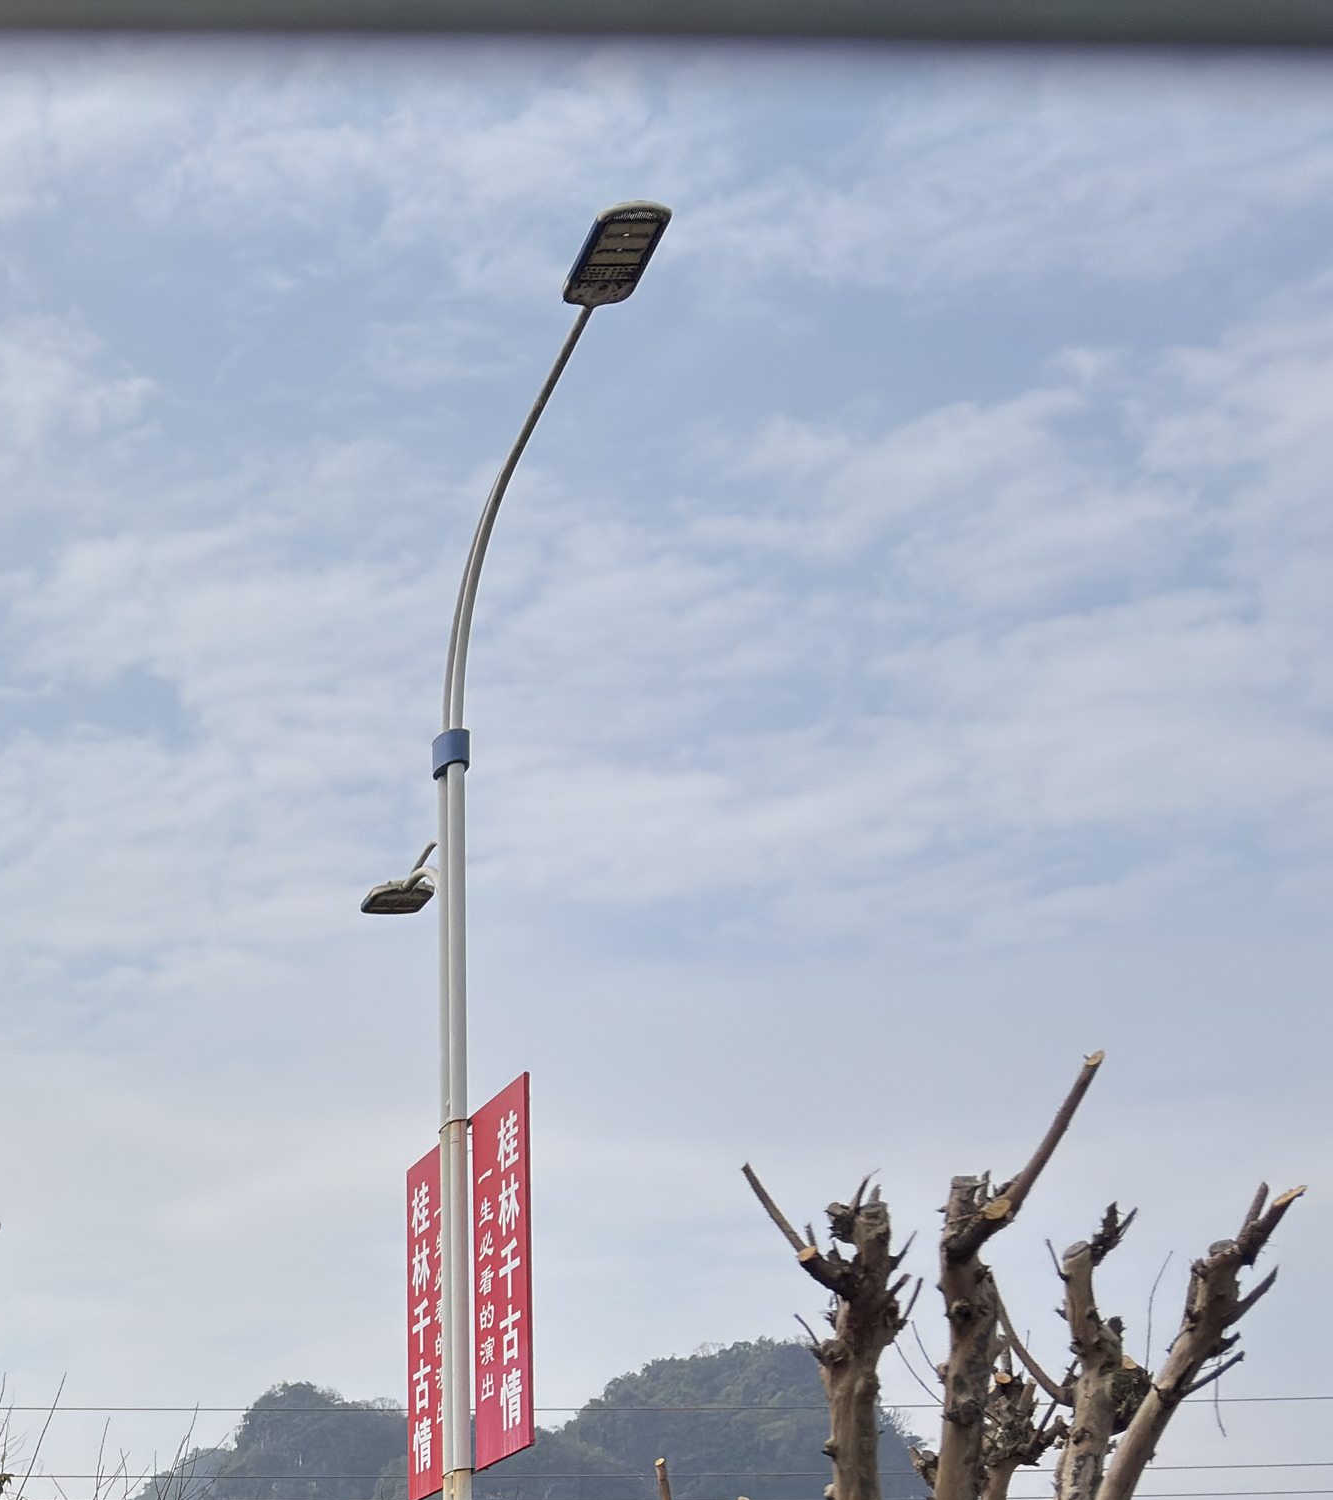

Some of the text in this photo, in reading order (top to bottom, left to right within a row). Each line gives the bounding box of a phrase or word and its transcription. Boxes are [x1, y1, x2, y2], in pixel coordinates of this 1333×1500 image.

[411, 1180, 432, 1474] 桂林千古情
[478, 1167, 495, 1402] 一生必看的演出
[497, 1108, 522, 1431] 桂林千古情
